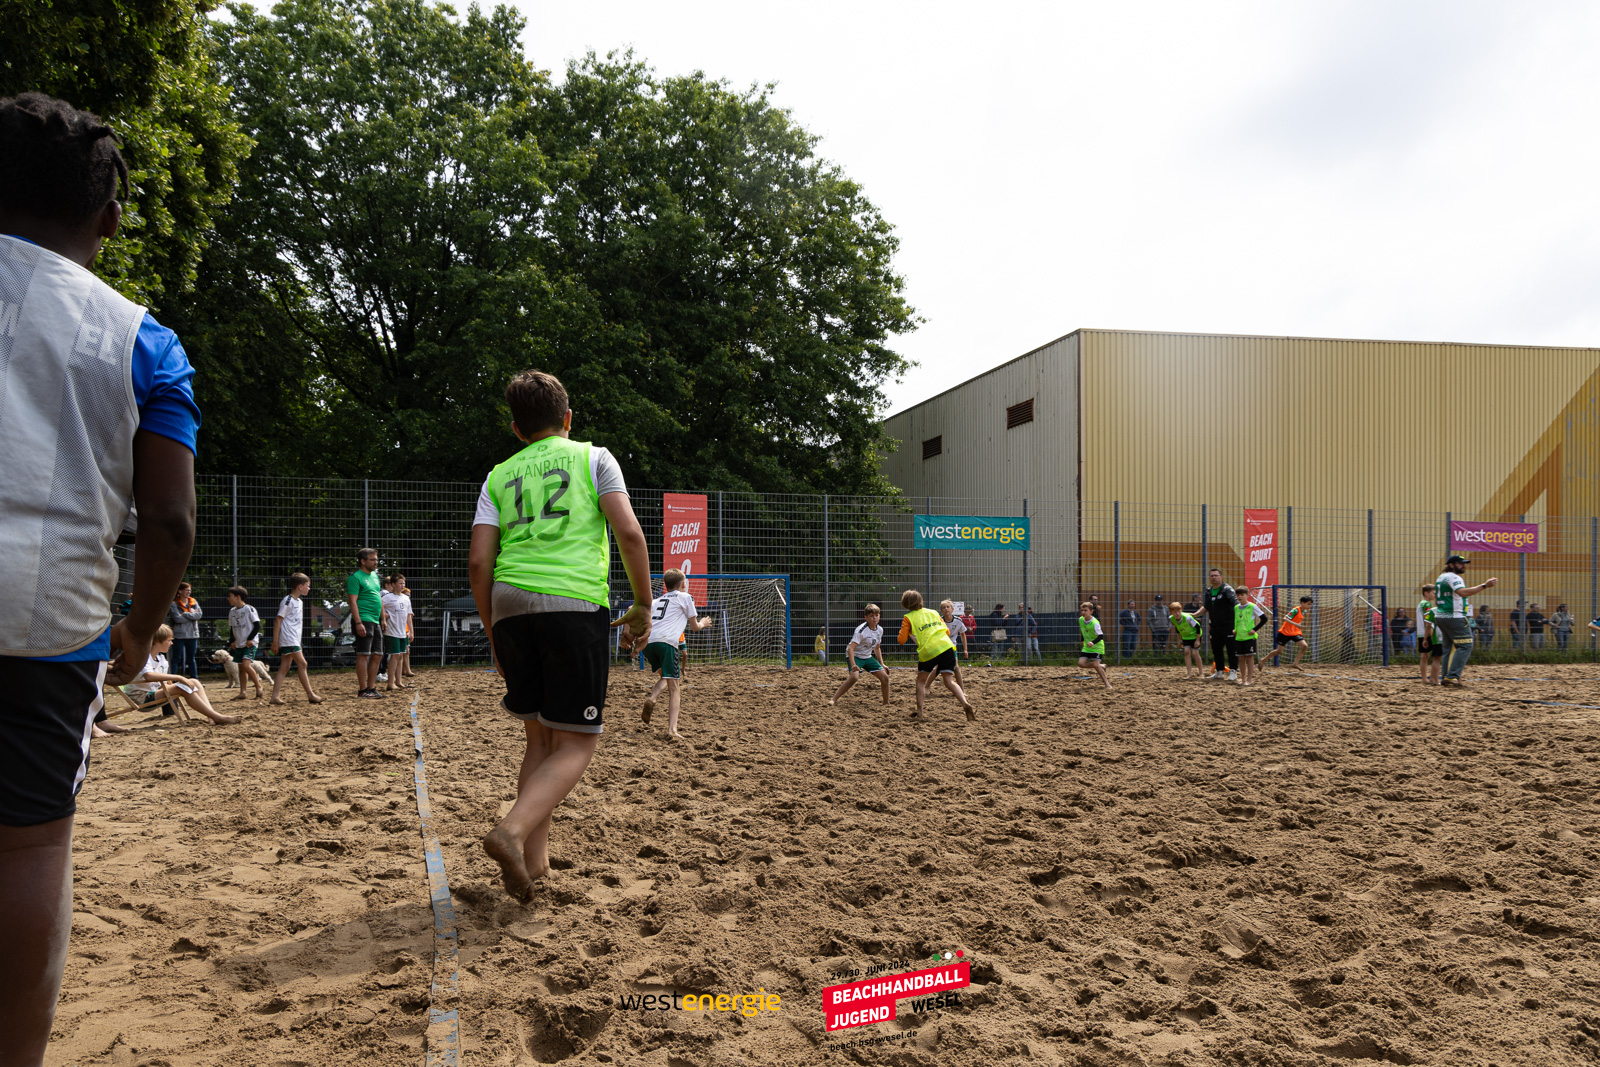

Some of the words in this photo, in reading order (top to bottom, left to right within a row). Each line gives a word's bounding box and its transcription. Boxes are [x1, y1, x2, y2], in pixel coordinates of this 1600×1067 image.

[506, 466, 521, 482] TV
[524, 456, 576, 480] ANRATH
[505, 468, 570, 529] 12
[670, 522, 700, 538] BEACH
[919, 523, 1025, 544] westenergie
[1454, 528, 1534, 547] westenergie
[670, 539, 700, 555] COURT
[1249, 532, 1273, 548] BEACH
[1250, 548, 1273, 562] COURT
[1256, 565, 1268, 604] 2
